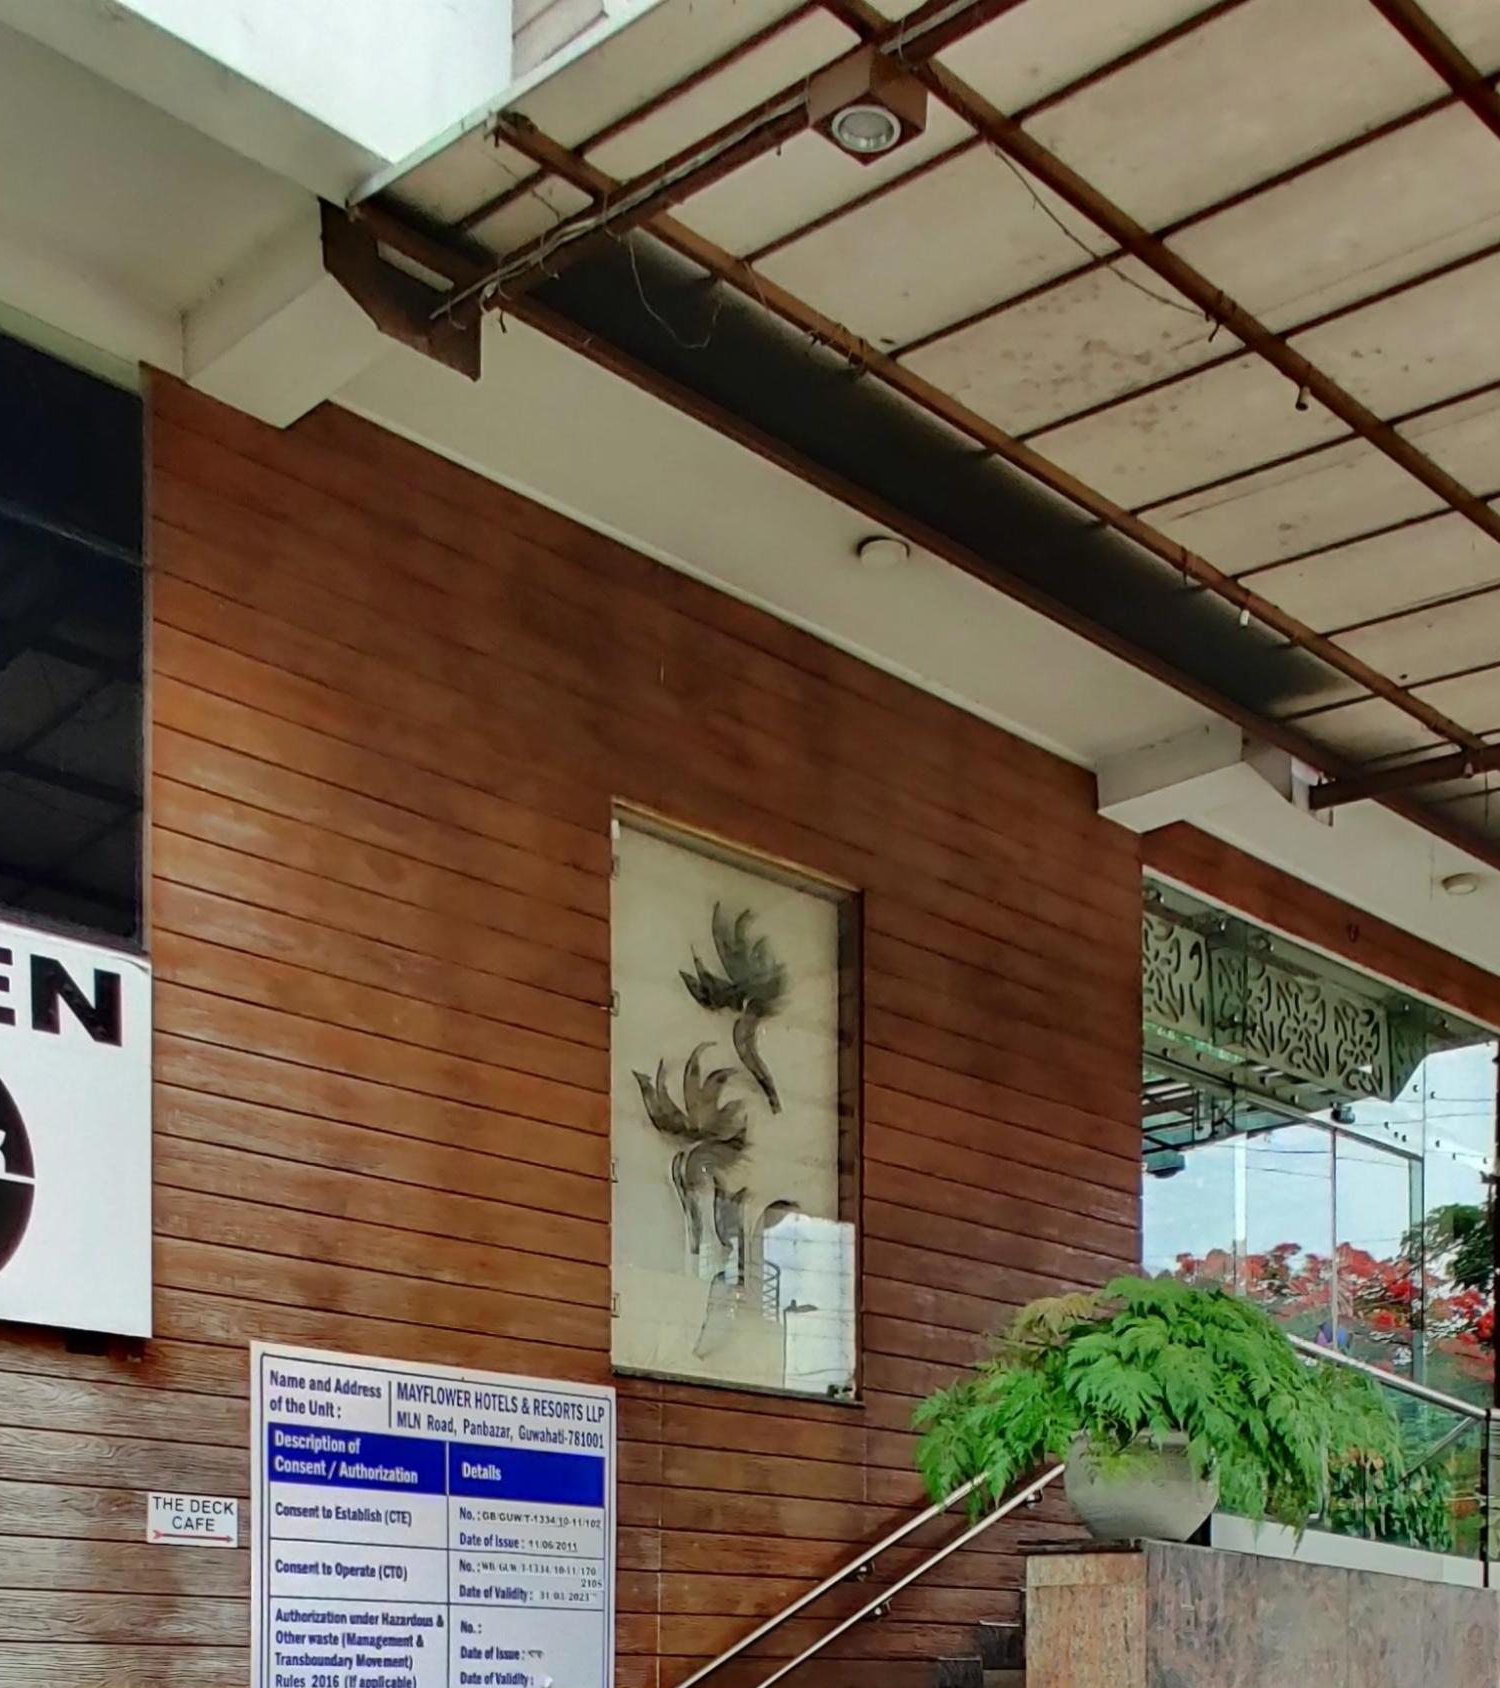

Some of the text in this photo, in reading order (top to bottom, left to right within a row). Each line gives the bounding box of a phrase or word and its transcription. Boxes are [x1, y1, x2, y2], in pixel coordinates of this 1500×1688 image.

[270, 1370, 382, 1399] Name and Address
[270, 1396, 283, 1411] of
[286, 1398, 305, 1414] the
[396, 1381, 605, 1423] MAYFLOWER HOTELS & RESORTS LLP
[396, 1410, 421, 1429] MLN
[426, 1414, 457, 1436] Road,
[463, 1418, 513, 1442] Panbazar,
[274, 1430, 361, 1454] Description of
[274, 1455, 326, 1476] Consent
[338, 1461, 419, 1484] Authorization
[462, 1461, 502, 1481] Details
[153, 1496, 234, 1516] THE DECK
[275, 1502, 412, 1528] Consent to Establish (CTE)
[172, 1515, 215, 1532] CAFE
[459, 1532, 483, 1547] Date
[484, 1534, 494, 1547] of
[495, 1534, 519, 1549] Issue
[275, 1559, 408, 1582] Consent to Operate (CTO)
[459, 1585, 483, 1598] Date
[484, 1586, 494, 1598] of
[494, 1587, 528, 1603] Validity
[275, 1608, 444, 1628] Authorization under Hazardous &
[275, 1630, 424, 1650] Other waste (Management &
[275, 1652, 413, 1671] Transboundary Movement)
[460, 1646, 482, 1659] Date
[484, 1646, 494, 1659] of
[495, 1646, 520, 1660] Issue
[275, 1674, 306, 1688] Rules
[311, 1674, 340, 1688] 2016
[460, 1671, 482, 1685] Date
[484, 1672, 494, 1685] of
[494, 1672, 528, 1688] Validity
